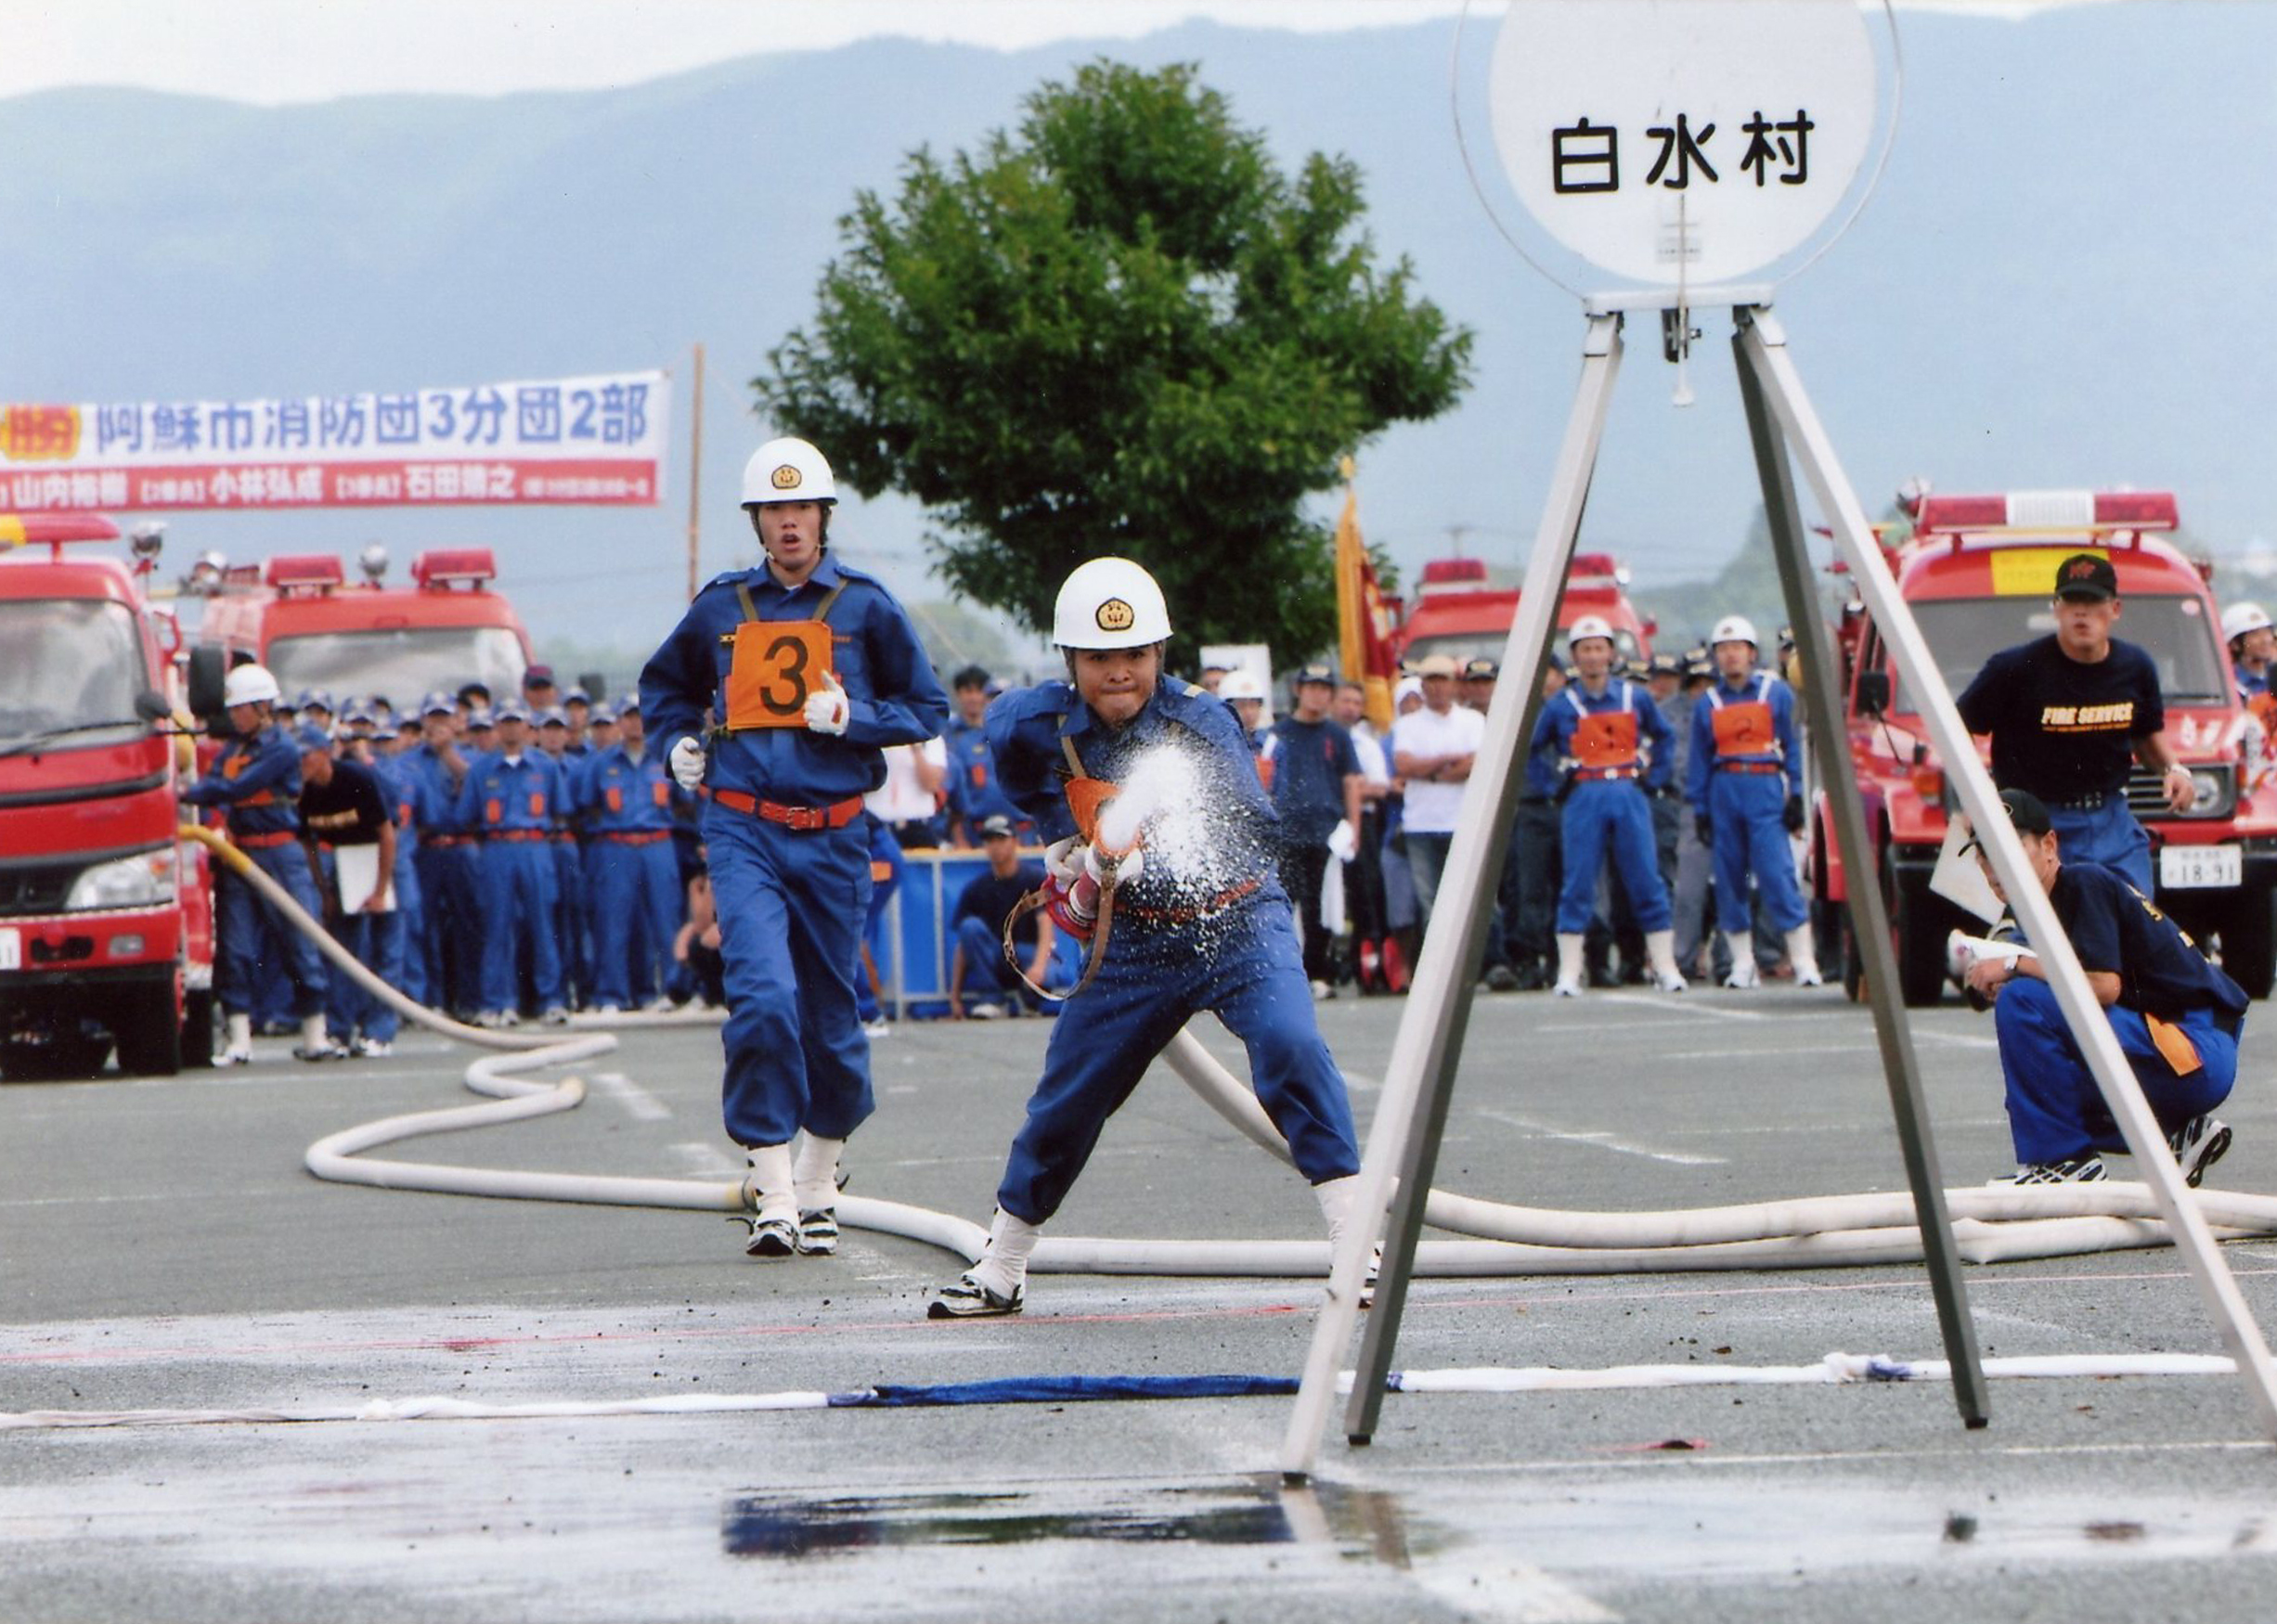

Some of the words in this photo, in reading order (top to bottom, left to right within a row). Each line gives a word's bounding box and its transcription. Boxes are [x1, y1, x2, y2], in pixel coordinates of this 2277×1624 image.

[1552, 110, 1815, 193] 白水村
[759, 635, 809, 716] 3
[2041, 706, 2077, 725] FIRE
[2077, 702, 2134, 725] SERVICE
